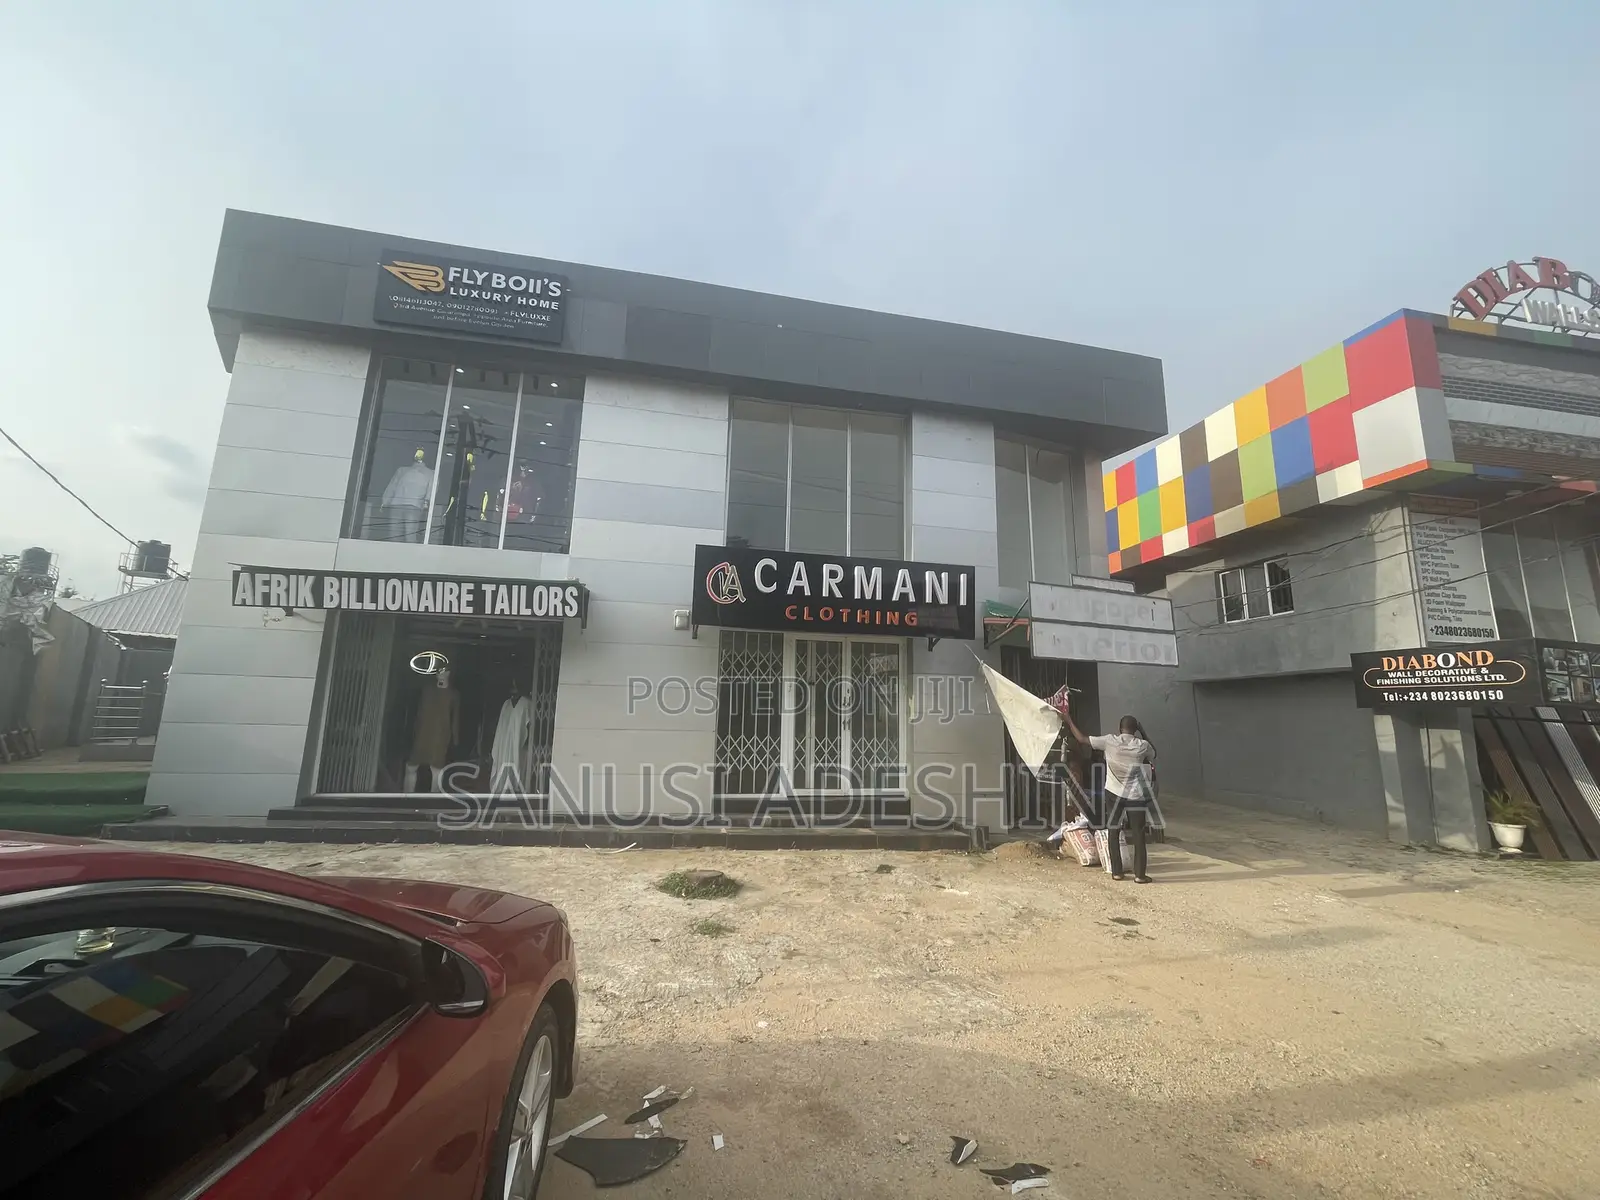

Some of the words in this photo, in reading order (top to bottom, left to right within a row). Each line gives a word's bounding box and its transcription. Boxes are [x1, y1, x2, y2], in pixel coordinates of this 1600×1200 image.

[448, 267, 562, 297] FLYBOII'S
[450, 287, 512, 303] LUXURY
[516, 296, 560, 310] HOME
[754, 558, 968, 606] CARMANI
[234, 572, 316, 608] AFRIK
[323, 576, 474, 614] BILLIONAIRE
[481, 583, 578, 618] TAILORS
[785, 604, 918, 626] CLOTHING
[1430, 626, 1494, 638] +2348023680150
[1382, 650, 1494, 672] DIABOND
[1376, 677, 1422, 686] FINISHING
[1424, 675, 1482, 684] SOLUTIONS
[1484, 674, 1507, 682] LTD.
[1388, 670, 1413, 678] WALL
[1416, 668, 1476, 677] DECORATIVE
[1431, 690, 1504, 701] 8023680150
